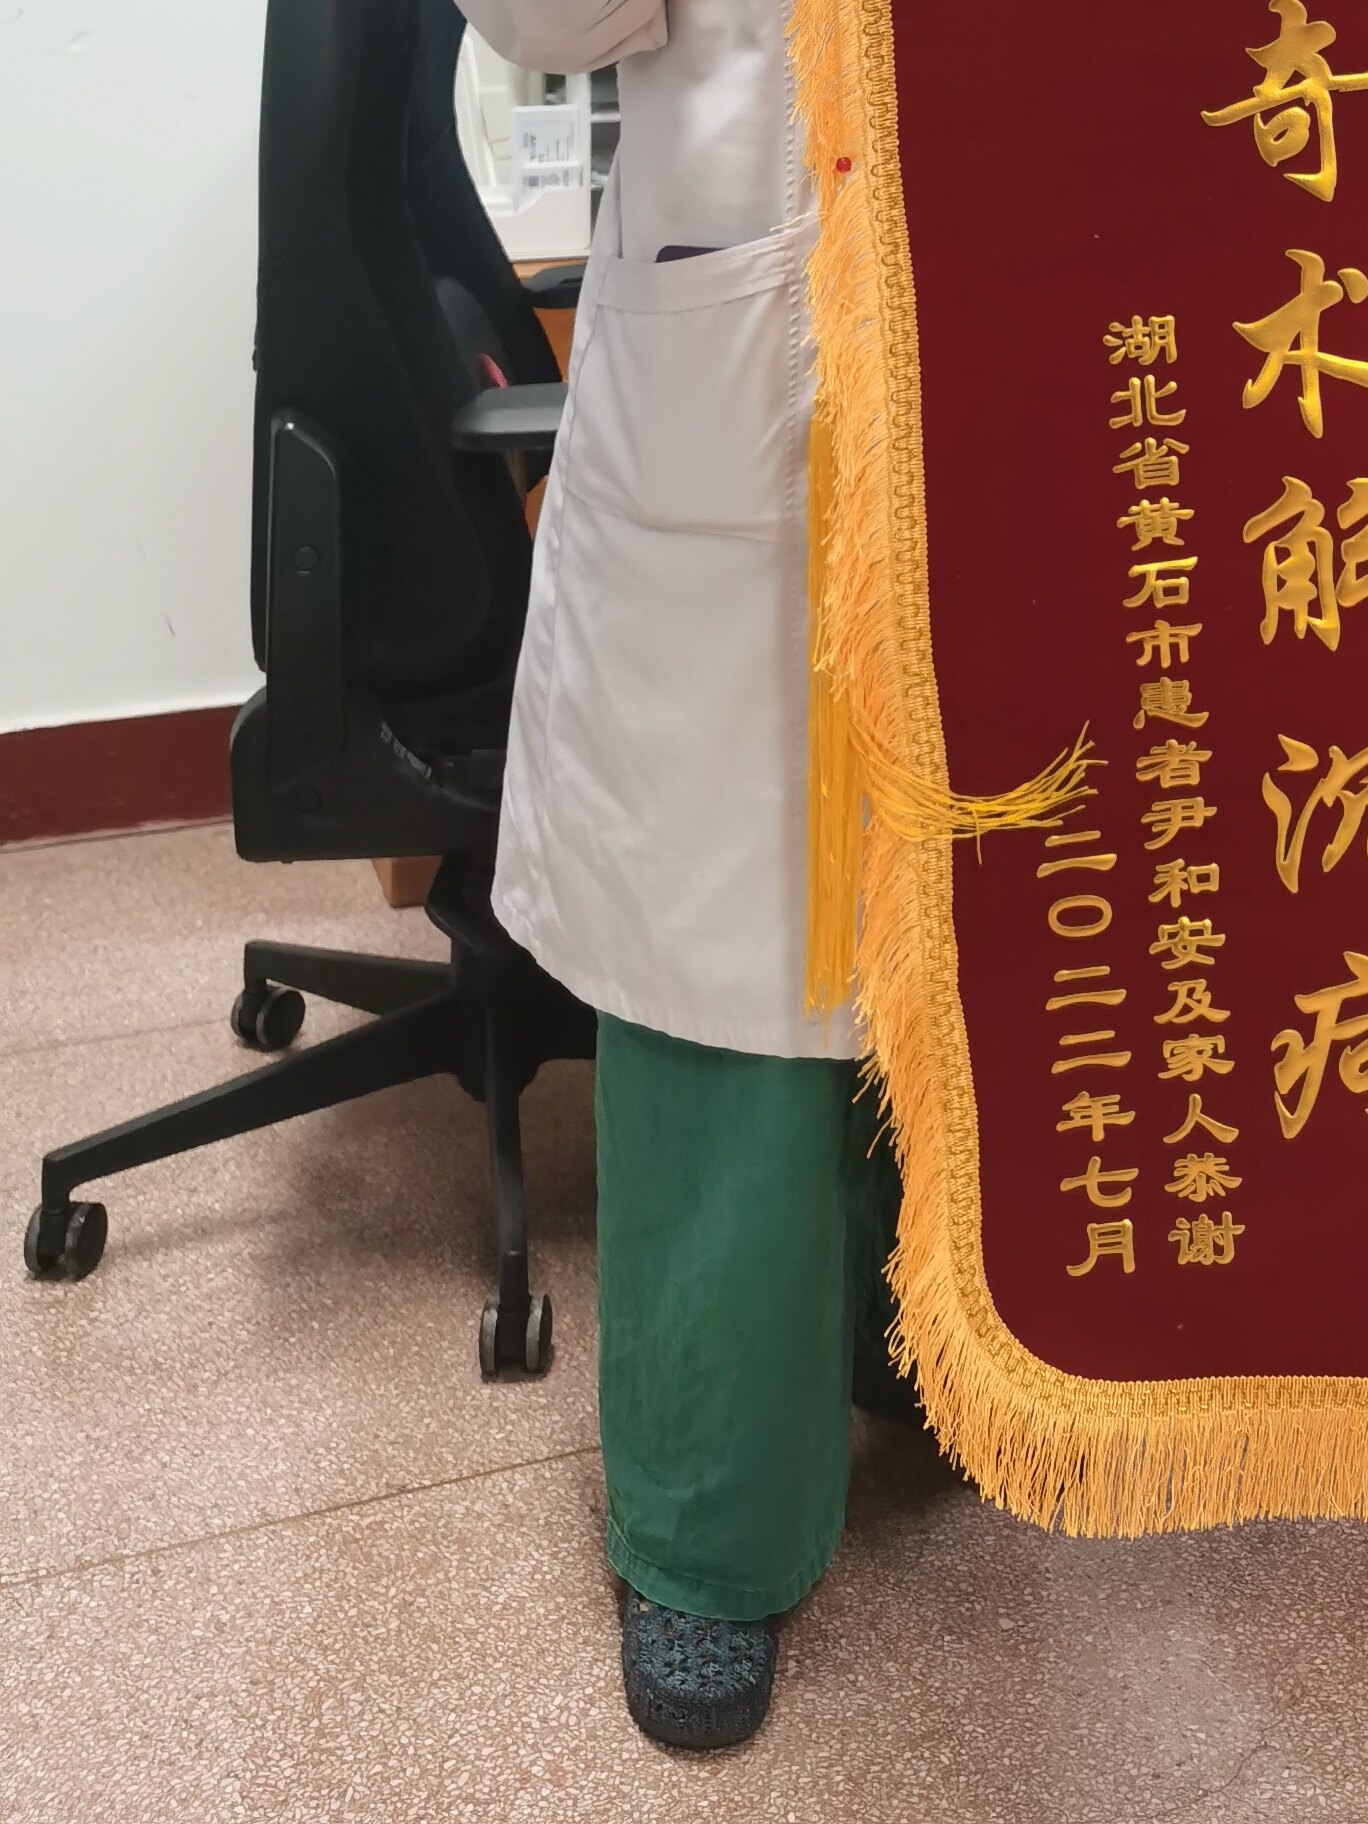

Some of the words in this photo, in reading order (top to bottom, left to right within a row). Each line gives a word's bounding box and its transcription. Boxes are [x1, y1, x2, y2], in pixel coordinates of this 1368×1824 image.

[1103, 314, 1246, 1274] 湖北省黄石市患者尹和安及家人恭谢
